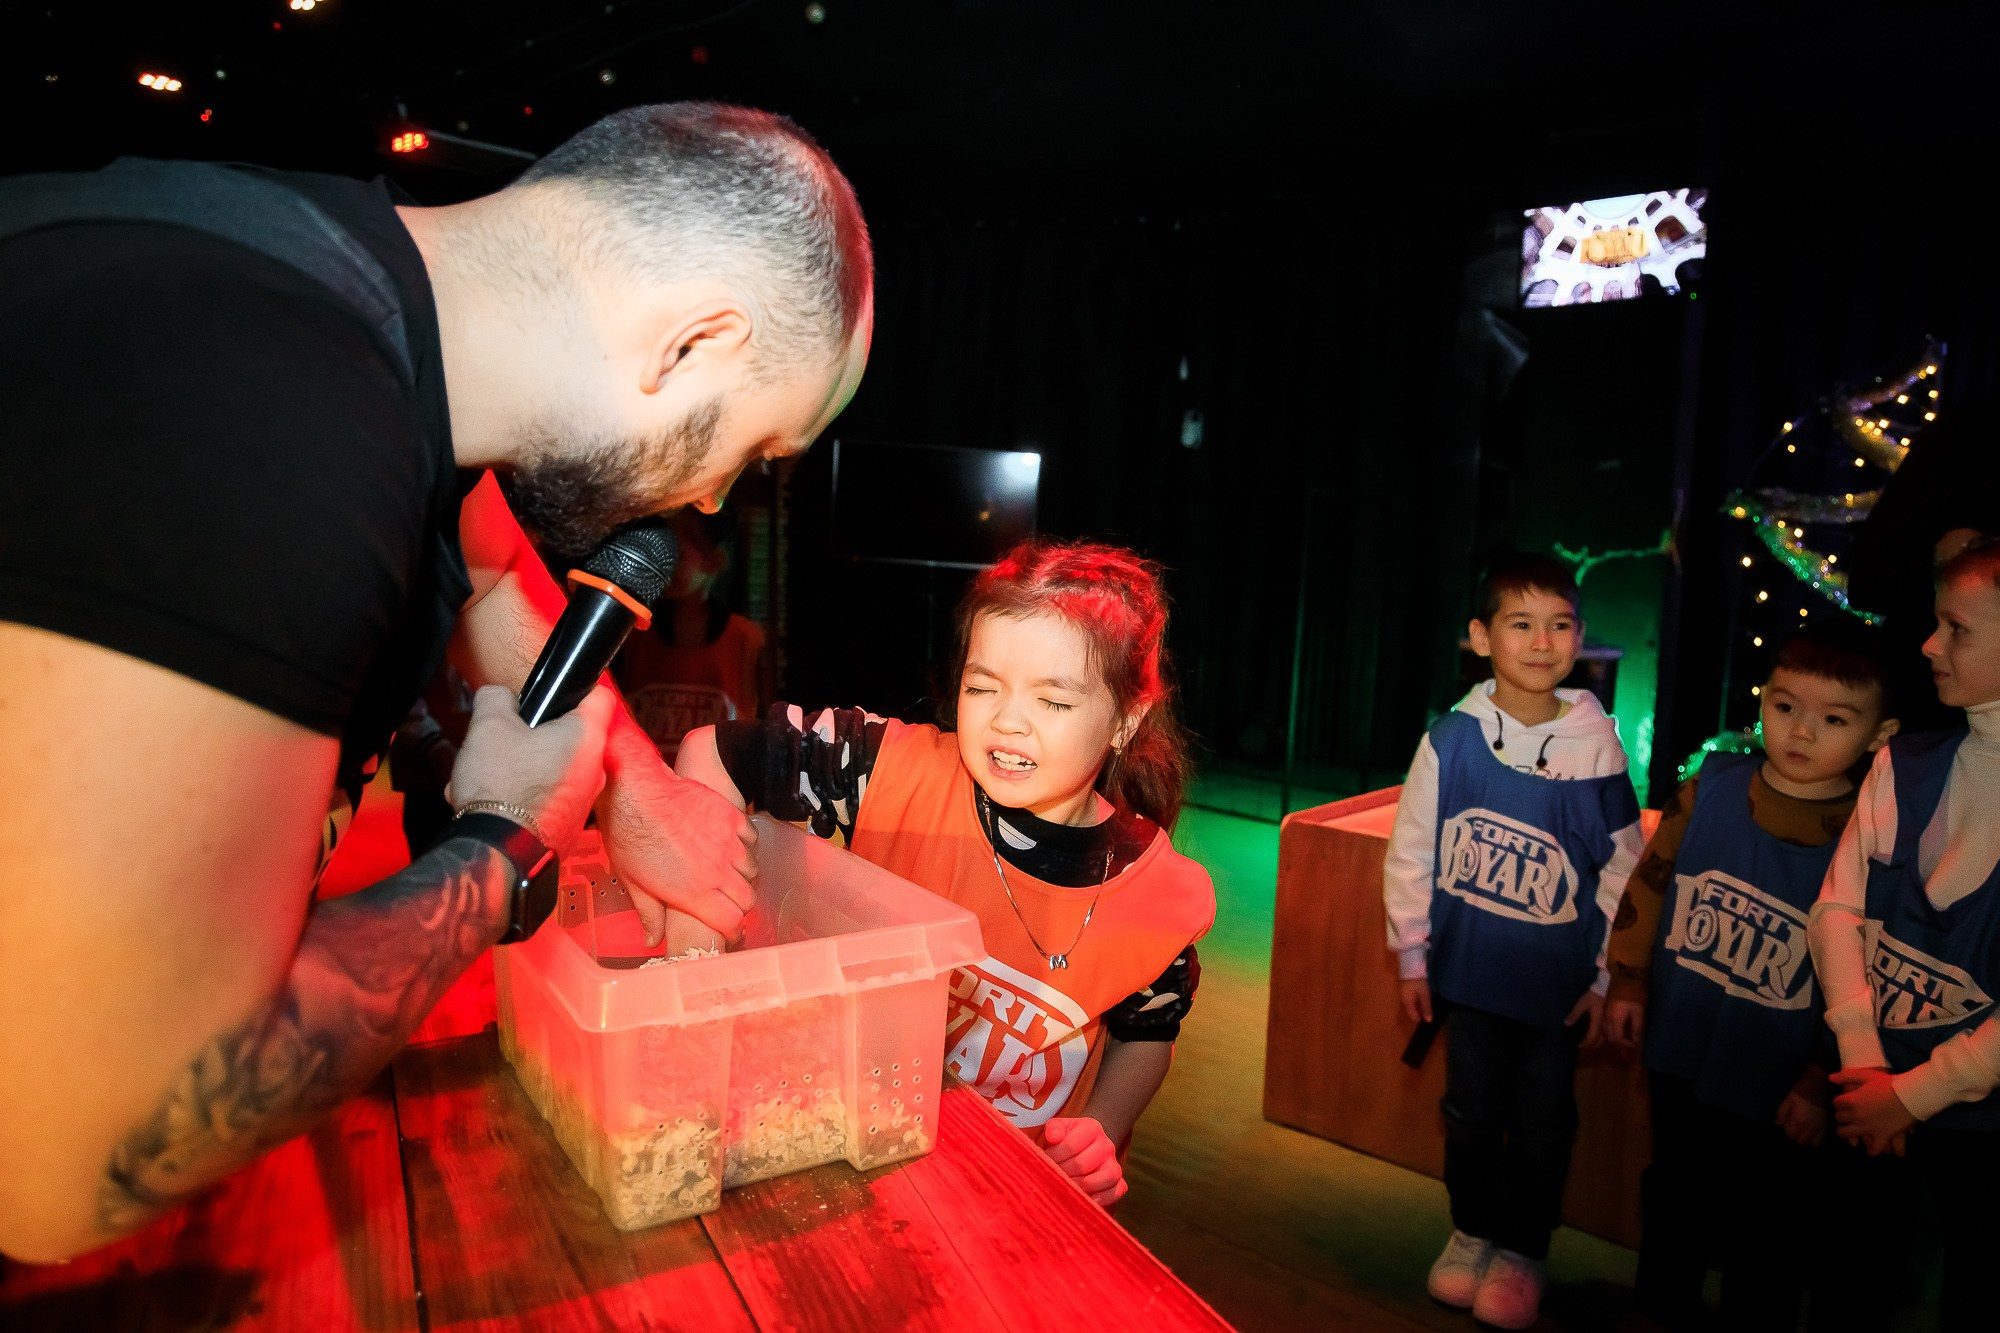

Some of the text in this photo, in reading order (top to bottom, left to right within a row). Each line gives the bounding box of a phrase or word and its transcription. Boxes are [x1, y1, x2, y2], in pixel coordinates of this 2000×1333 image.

[1474, 820, 1546, 858] FORT
[1703, 882, 1790, 933] FORT
[1049, 954, 1068, 970] M
[1872, 946, 1947, 1000] ORT
[948, 965, 1048, 1035] ORT
